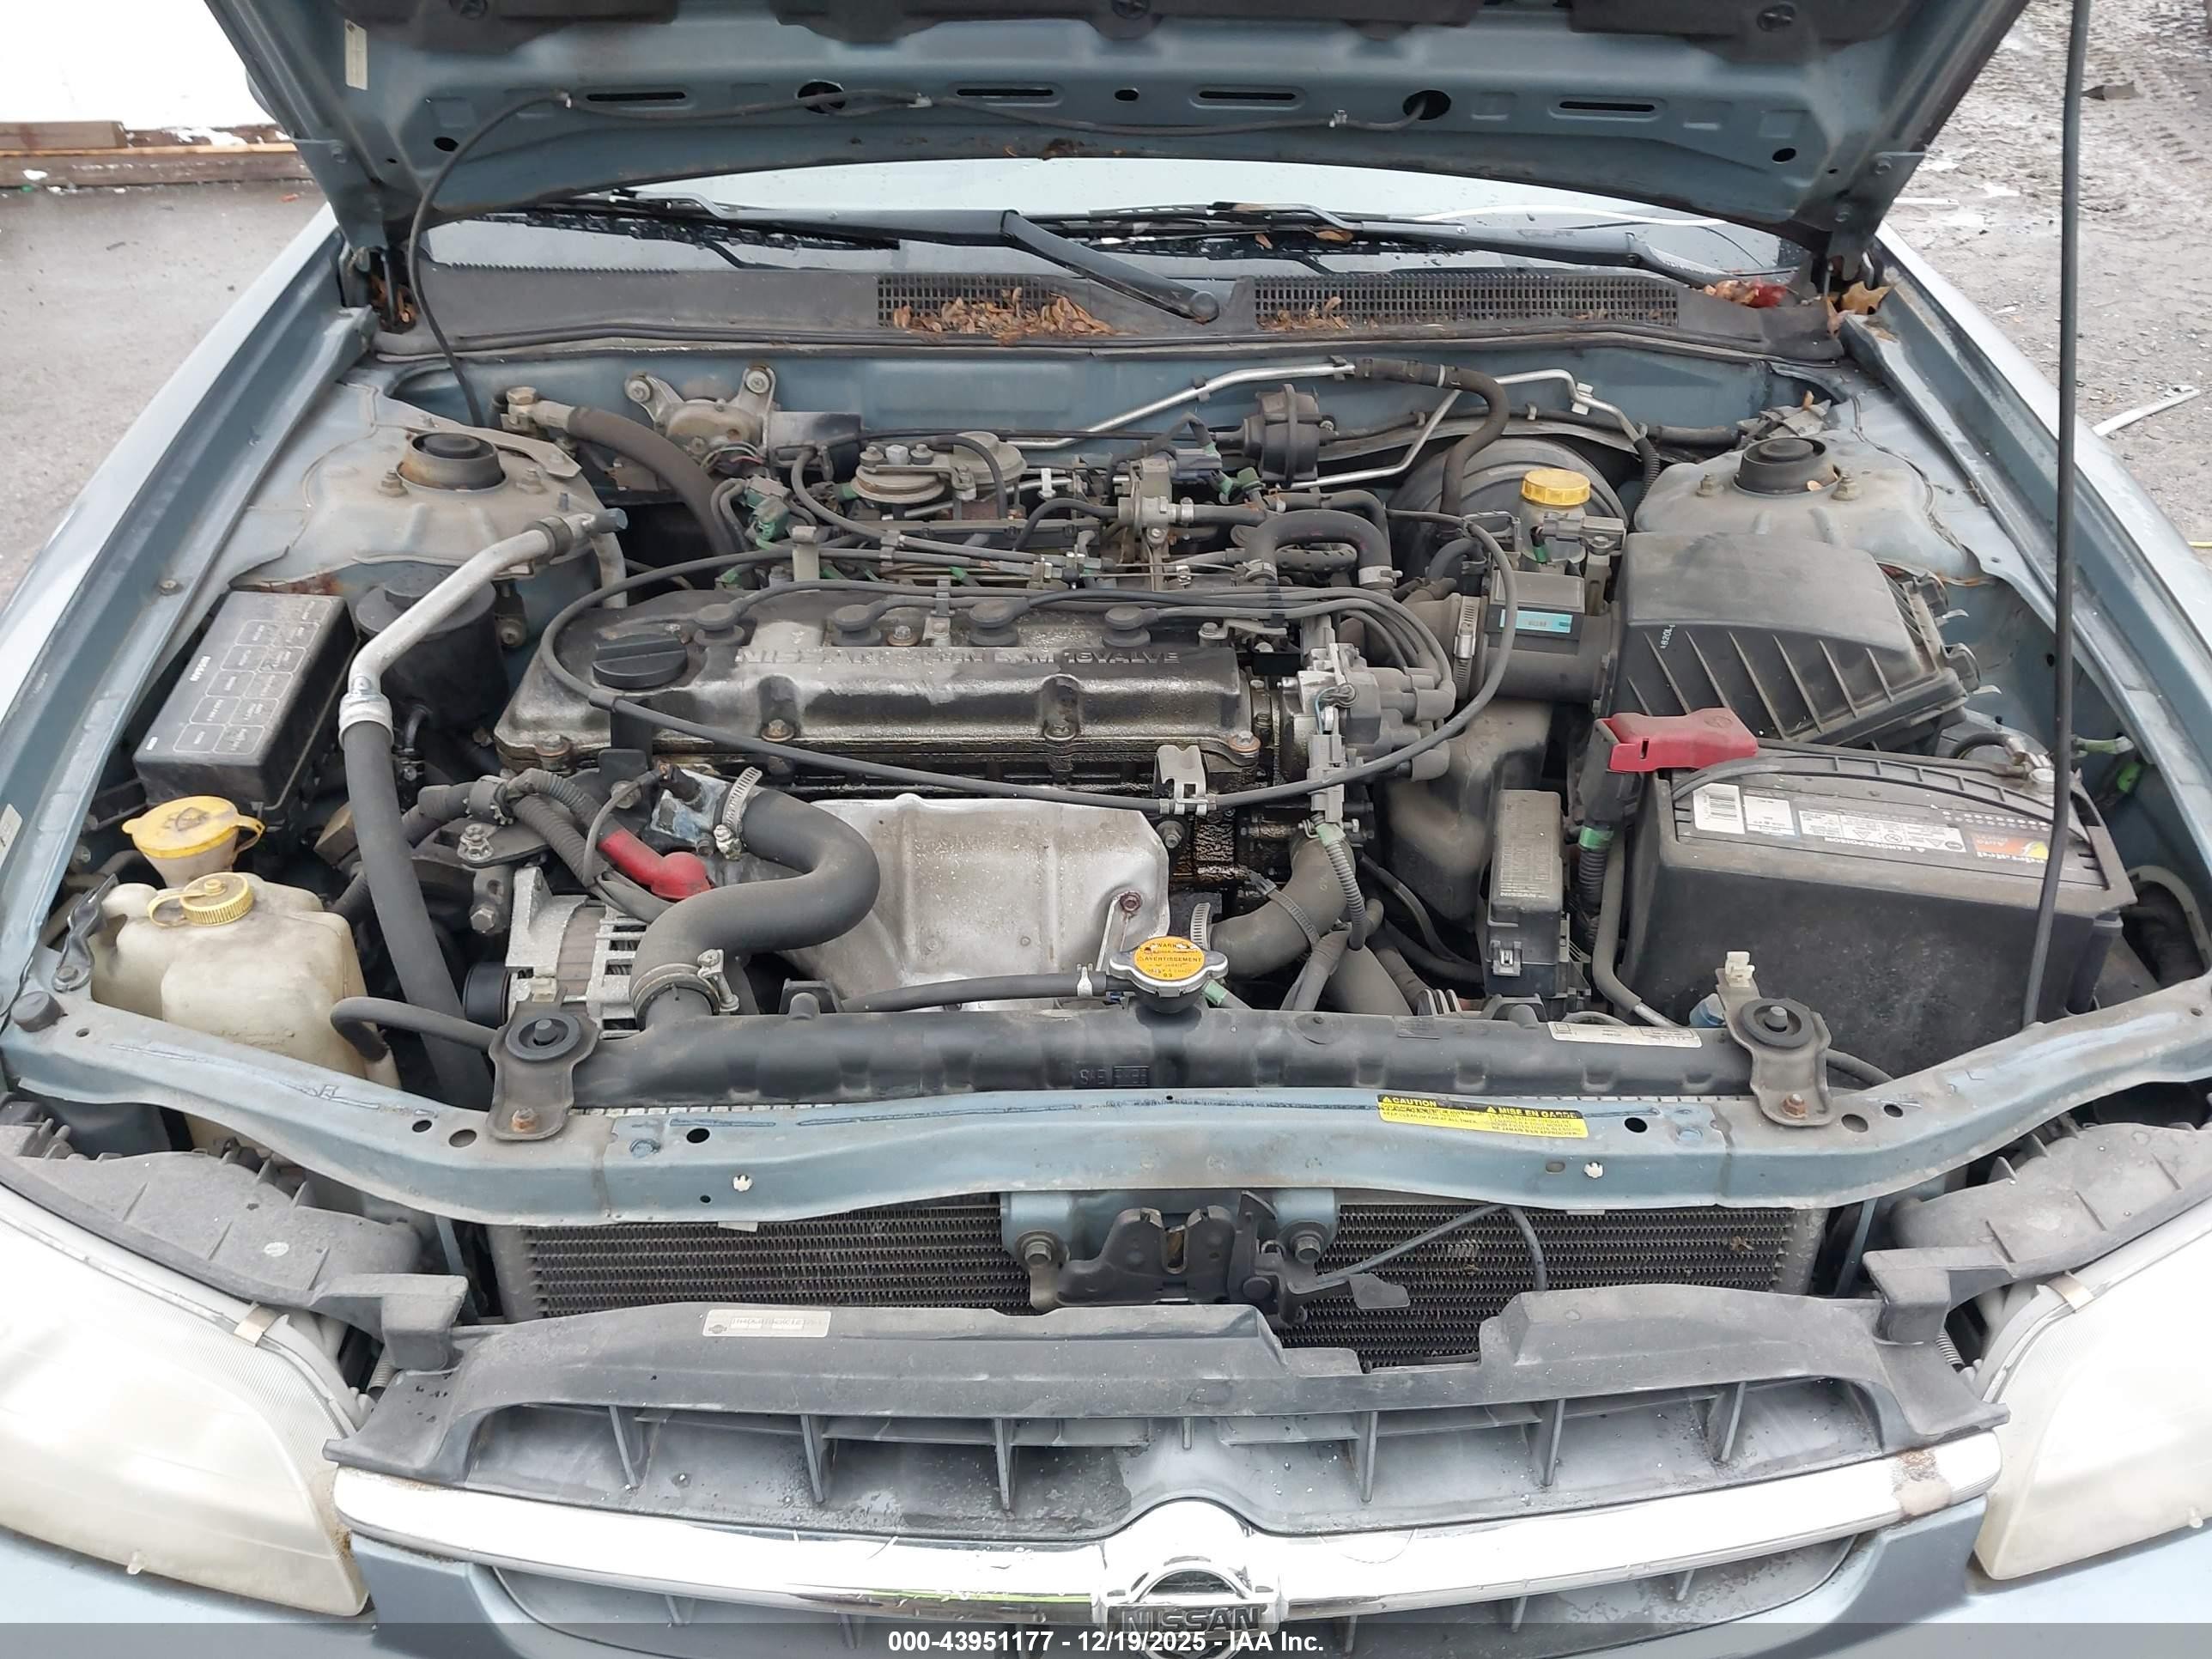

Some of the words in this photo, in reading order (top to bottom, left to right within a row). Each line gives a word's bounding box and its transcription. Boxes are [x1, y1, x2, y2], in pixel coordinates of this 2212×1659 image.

[735, 650, 878, 665] NISSAN
[1393, 1097, 1437, 1108] CAUTION
[1498, 1106, 1522, 1116] MISE
[1121, 1607, 1261, 1632] NISSAN
